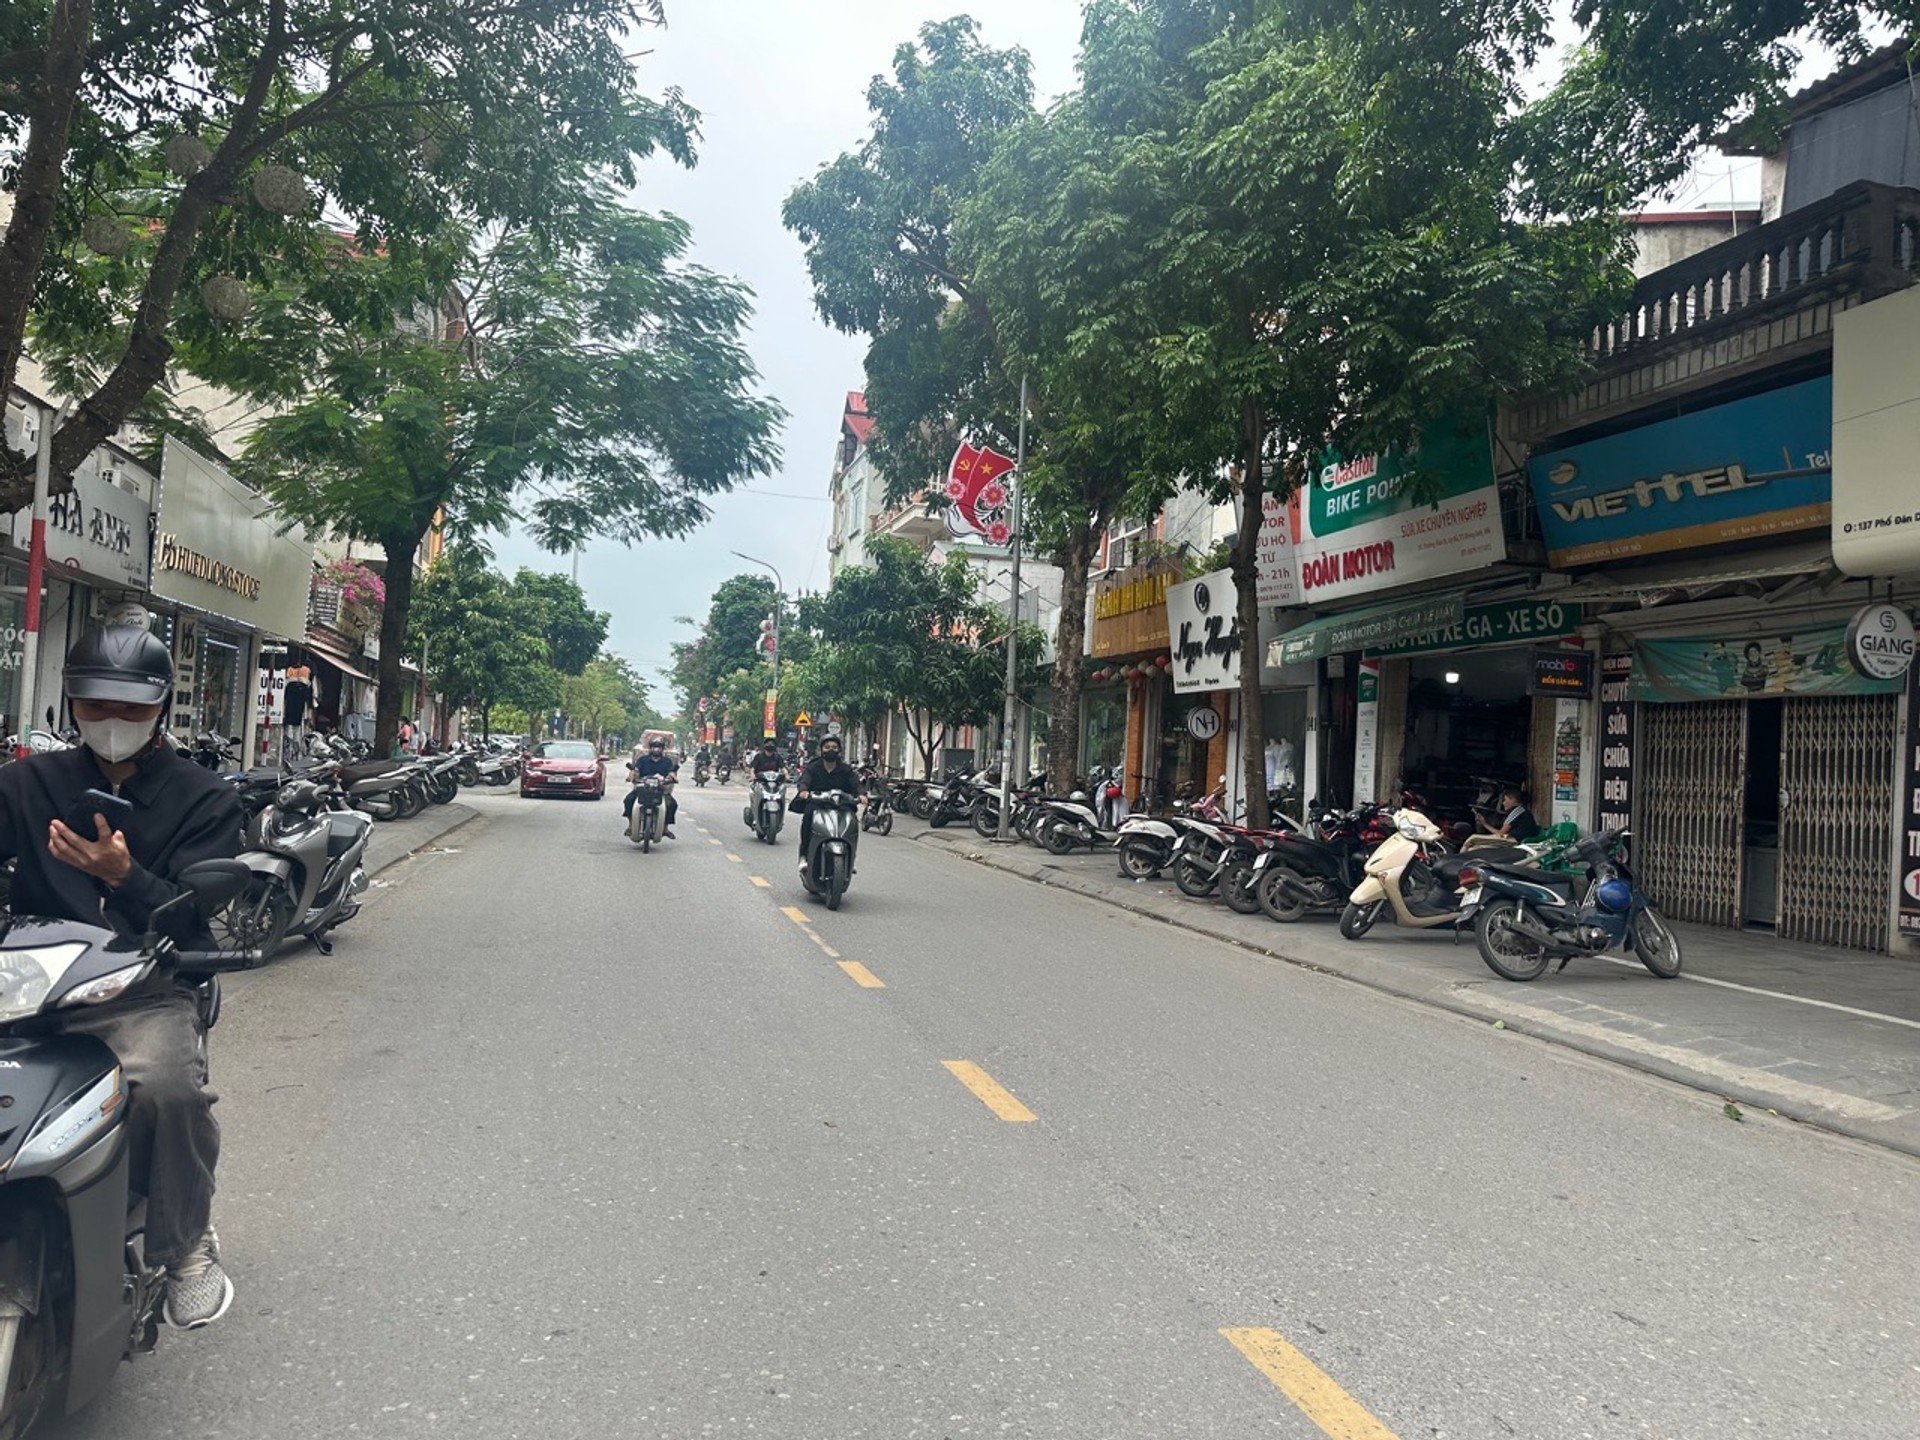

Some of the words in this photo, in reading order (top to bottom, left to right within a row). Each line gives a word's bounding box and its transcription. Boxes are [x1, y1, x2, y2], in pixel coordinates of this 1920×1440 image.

[1805, 449, 1831, 469] Tel
[1326, 489, 1360, 518] BIKE
[1272, 568, 1290, 580] 21h
[1302, 550, 1339, 590] ĐOÀN
[1342, 539, 1395, 578] MOTOR
[1442, 623, 1464, 643] XE
[1466, 614, 1493, 637] GA
[1507, 608, 1530, 633] XE
[1534, 600, 1564, 629] SỐ
[1860, 635, 1913, 656] GIANG
[1607, 706, 1628, 735] SỬA
[1603, 742, 1630, 768] CHỮA
[1604, 776, 1628, 805] ĐIỆN
